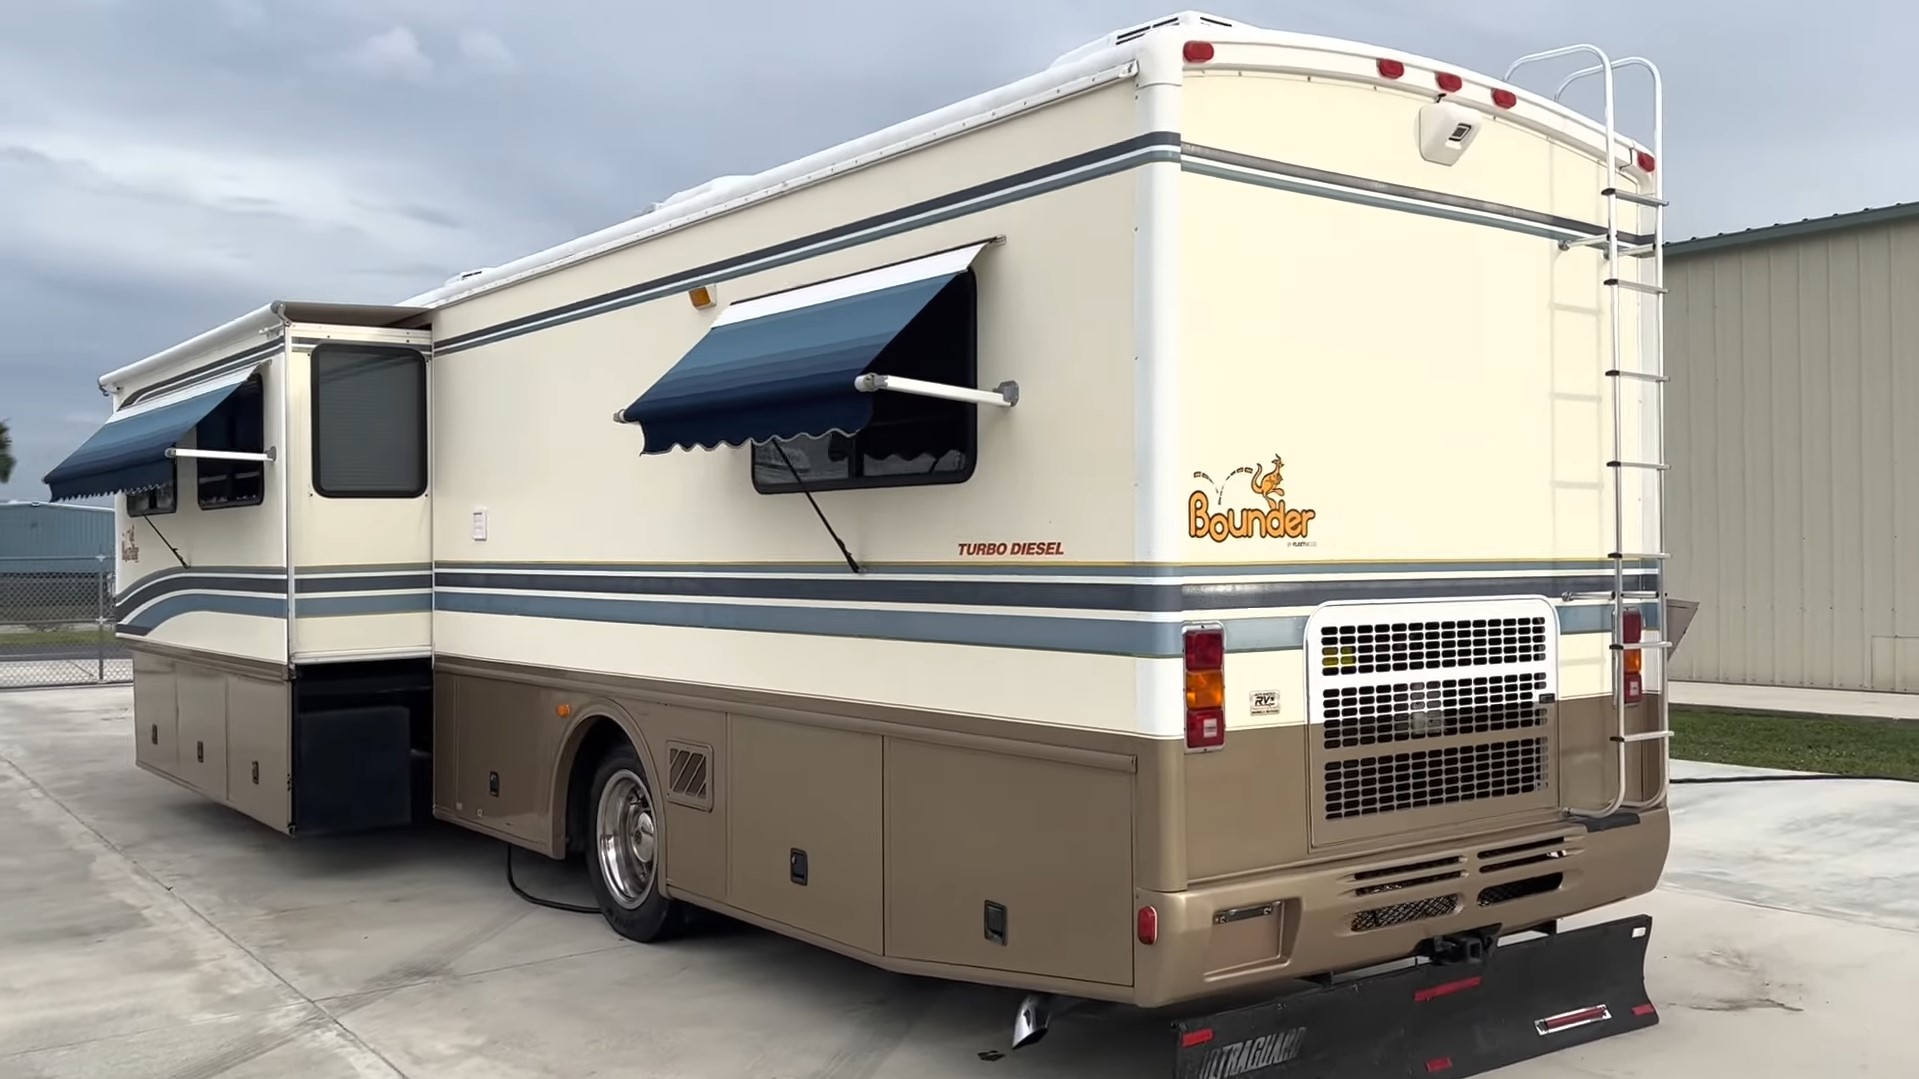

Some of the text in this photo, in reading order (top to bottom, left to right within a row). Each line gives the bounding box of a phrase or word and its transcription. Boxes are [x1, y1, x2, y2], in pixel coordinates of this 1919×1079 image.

[1188, 490, 1317, 543] Bounder
[958, 542, 1065, 556] TURBO DIESEL
